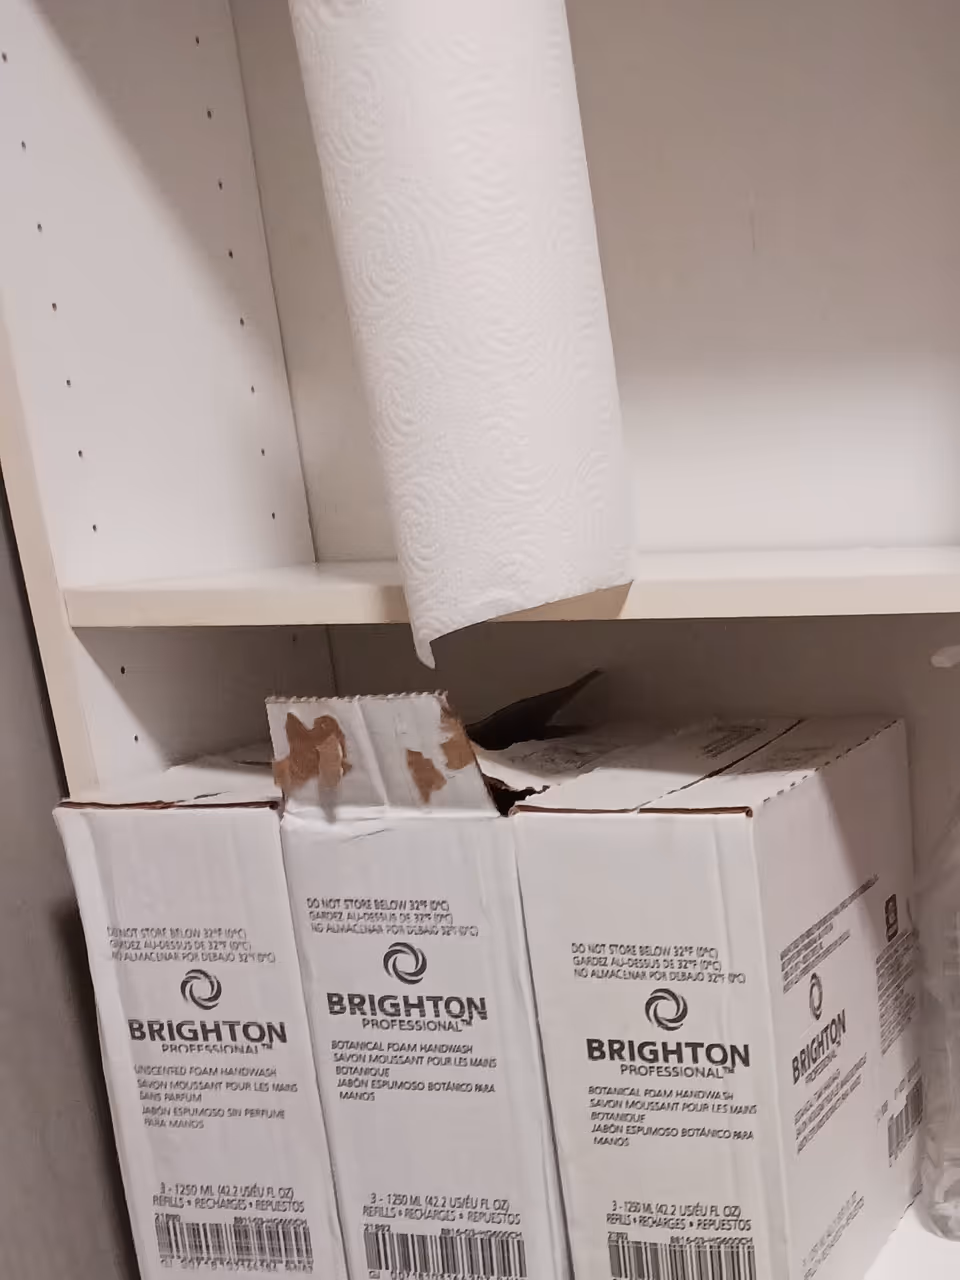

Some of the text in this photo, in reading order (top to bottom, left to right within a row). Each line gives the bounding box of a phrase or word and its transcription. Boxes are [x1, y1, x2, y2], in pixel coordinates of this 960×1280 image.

[588, 943, 606, 954] NOT
[609, 944, 637, 956] STORE
[639, 945, 671, 957] BELOW
[573, 956, 608, 967] GARDEZ
[327, 992, 487, 1020] BRIGHTON
[128, 1019, 287, 1043] BRIGHTON
[332, 1040, 473, 1054] BOTANICAL FOAM HANDWASH
[586, 1038, 751, 1068] BRIGHTON
[792, 1008, 846, 1085] BRIGHTON
[334, 1053, 366, 1063] SAVON
[427, 1057, 450, 1066] POUR
[189, 1066, 218, 1076] FOAM
[336, 1066, 390, 1077] BOTANIQUE
[371, 1080, 425, 1091] ESPUMOSO
[339, 1091, 375, 1101] MANOS
[588, 1086, 733, 1100] BOTANICAL FOAM HANDWASH
[625, 1100, 680, 1111] MOUSSANT
[682, 1103, 709, 1112] POUR
[712, 1103, 727, 1113] LES
[169, 1119, 204, 1129] MANOS
[626, 1125, 679, 1137] ESPUMOSO
[681, 1127, 731, 1139] BOTÁNICO
[594, 1136, 629, 1147] MANOS
[467, 1211, 521, 1225] REPUESTOS
[696, 1218, 752, 1231] REPUESTOS
